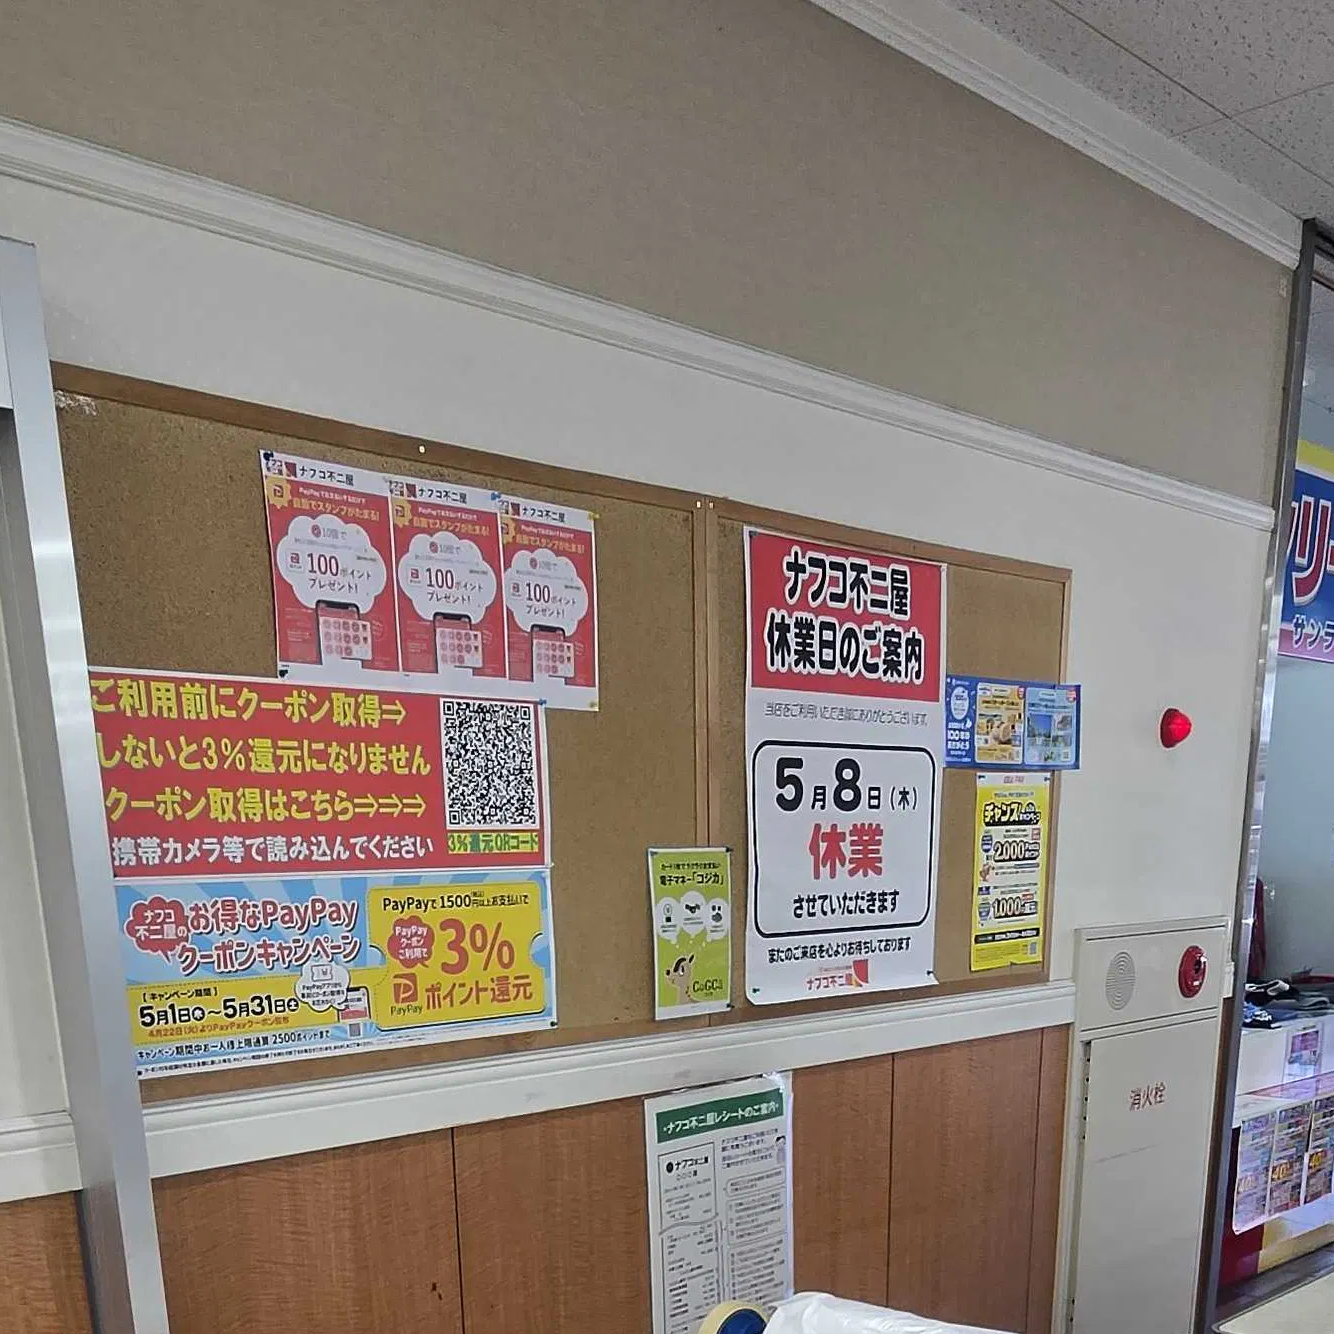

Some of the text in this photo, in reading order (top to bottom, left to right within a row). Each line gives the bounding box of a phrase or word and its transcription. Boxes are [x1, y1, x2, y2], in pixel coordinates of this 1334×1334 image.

[784, 548, 910, 617] ナフコ不二屋
[766, 611, 923, 681] 休業日のご案内
[91, 678, 383, 729] ご利用前にクーポン取得
[97, 732, 432, 776] しないと3%還元になりません
[775, 757, 918, 812] 5月8日(木)
[105, 786, 354, 822] クーポン取得はこちら
[113, 834, 434, 866] 携帯カメラ等で読み込んでください
[809, 822, 884, 880] 休業
[143, 908, 175, 924] ナフコ
[188, 898, 359, 934] お得なPayPay
[793, 889, 899, 919] させていただきます
[394, 925, 428, 937] PayPay
[438, 917, 516, 975] 3%
[177, 934, 362, 977] クーポンキャンペーン
[425, 974, 533, 1010] ポイント還元
[390, 1004, 423, 1017] PayPay
[1130, 1082, 1166, 1111] 消火栓
